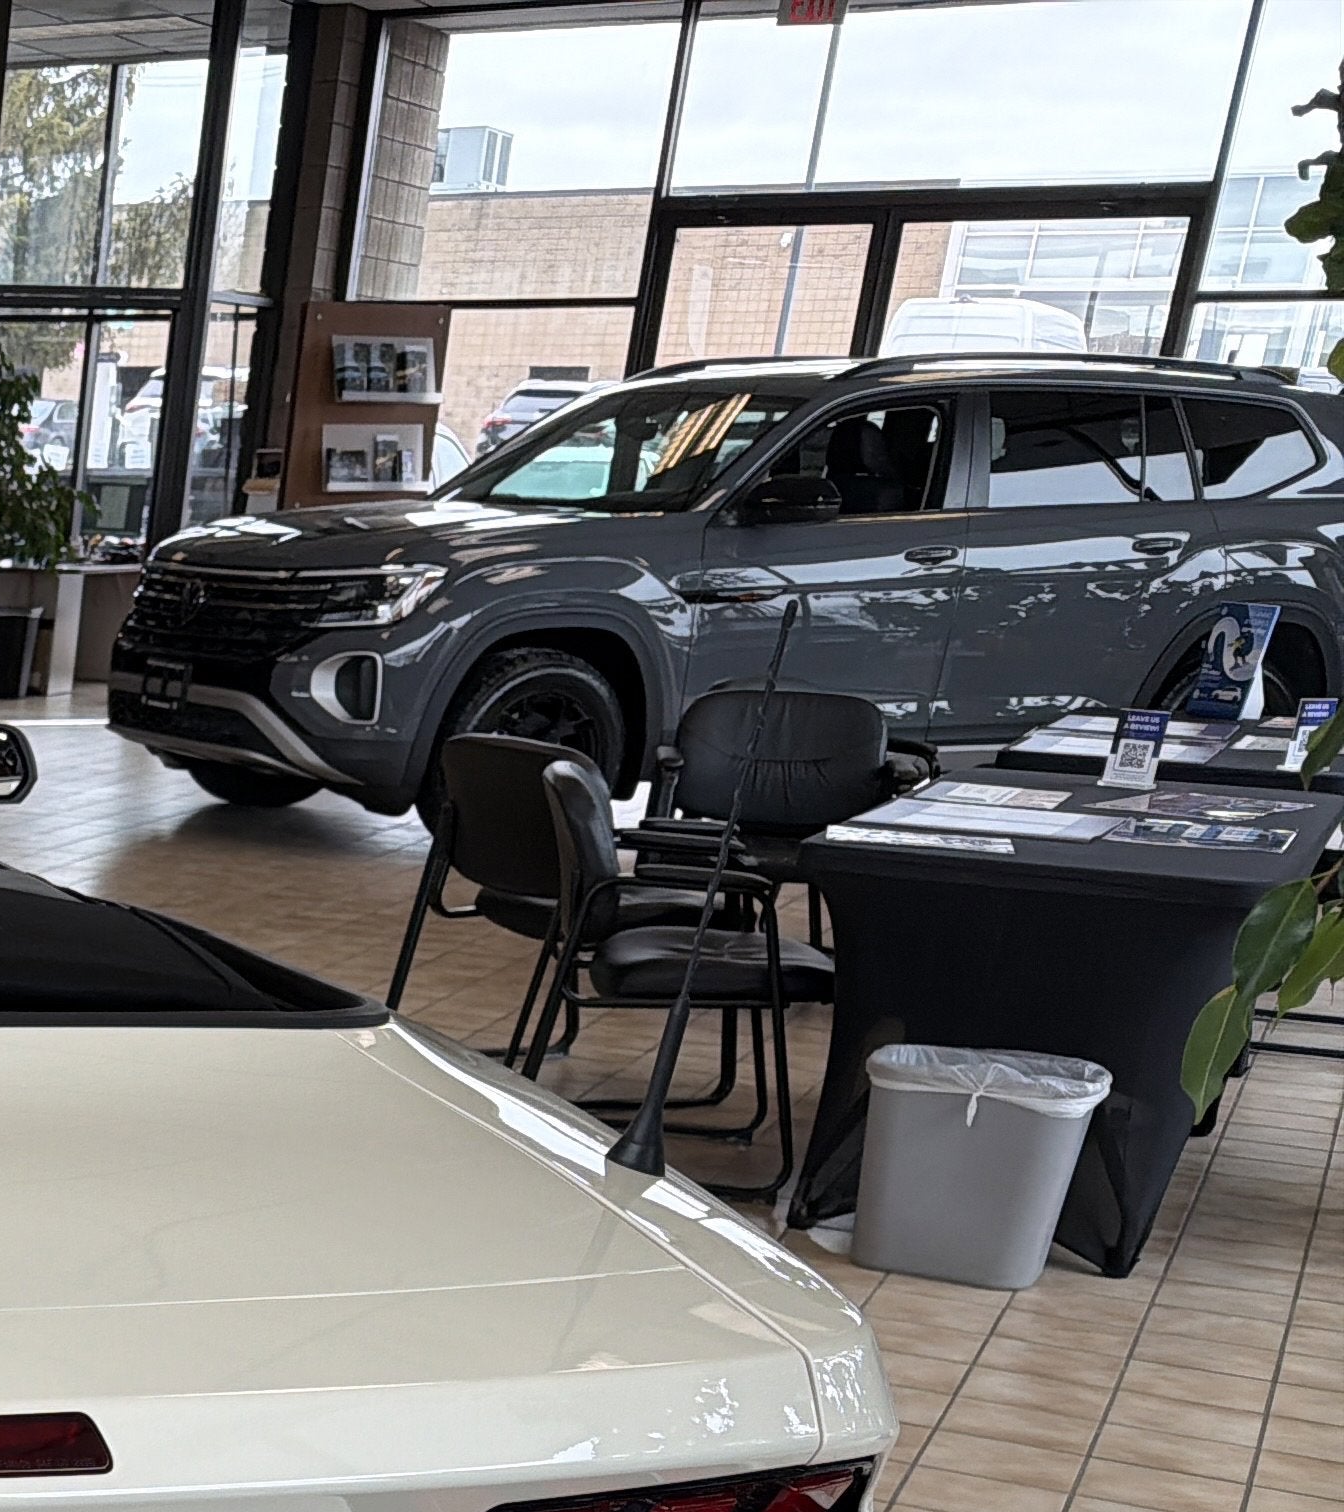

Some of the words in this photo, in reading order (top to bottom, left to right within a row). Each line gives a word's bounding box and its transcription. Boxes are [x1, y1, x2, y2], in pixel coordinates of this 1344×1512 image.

[1127, 713, 1150, 722] LEAVE
[1150, 715, 1161, 724] US
[1130, 722, 1160, 732] REVIEW!
